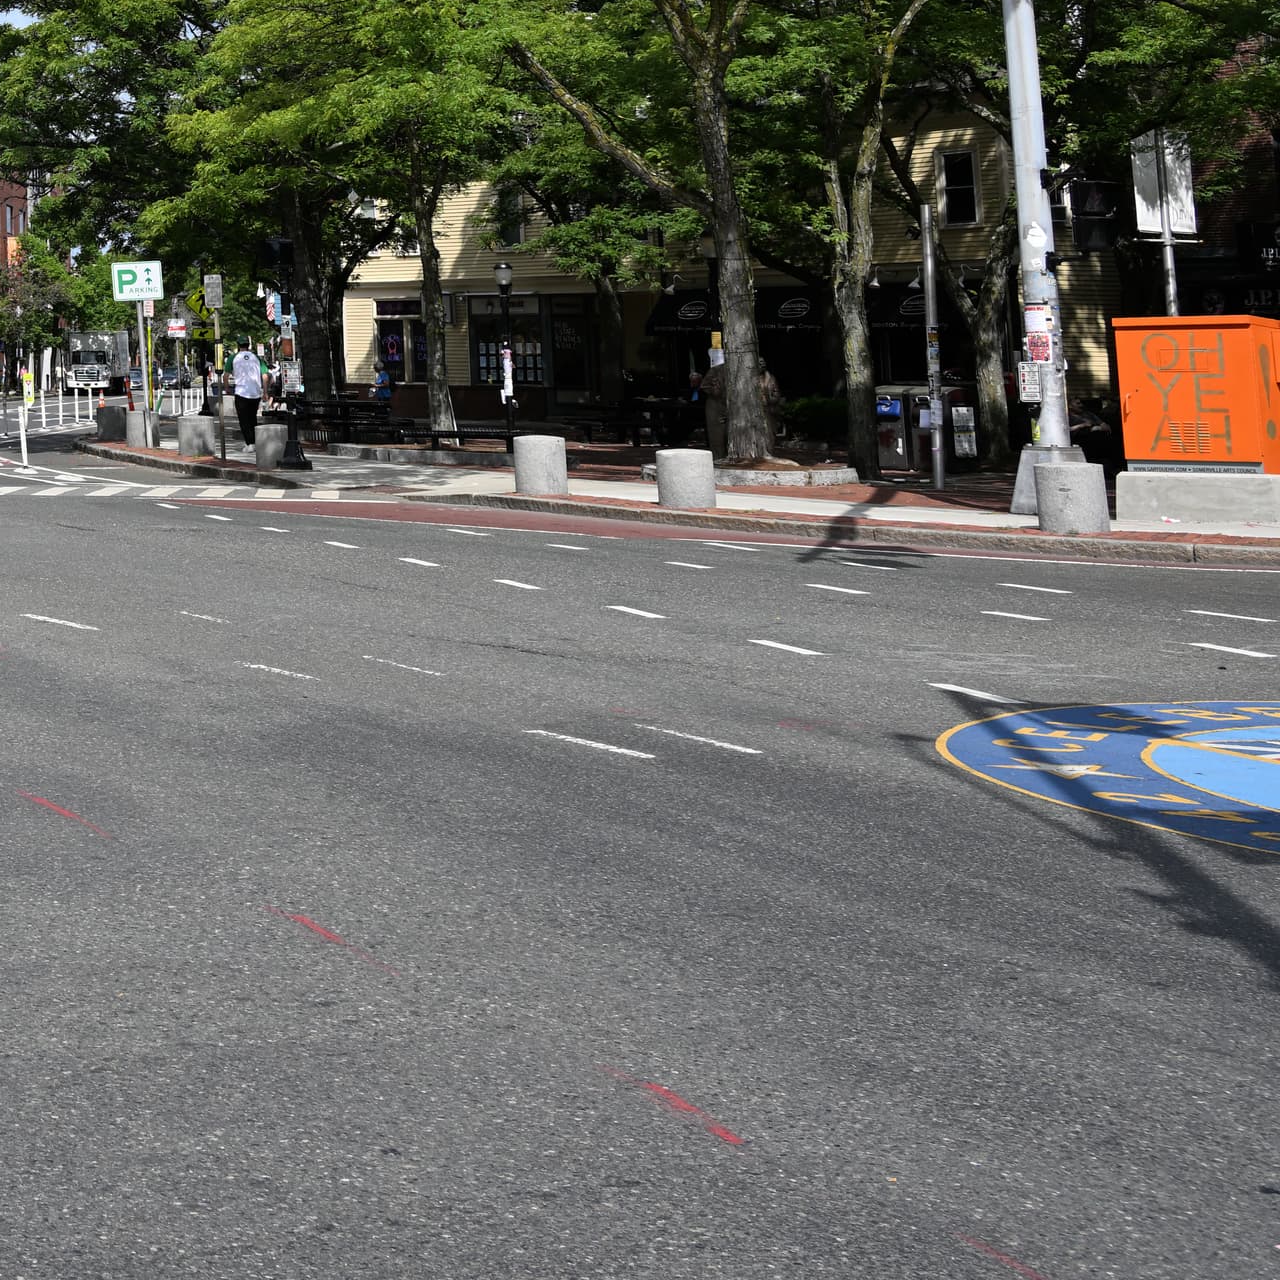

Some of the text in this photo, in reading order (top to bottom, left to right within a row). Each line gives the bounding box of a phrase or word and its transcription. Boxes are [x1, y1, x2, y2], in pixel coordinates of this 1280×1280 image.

[1141, 332, 1225, 372] OH
[1146, 373, 1230, 413] YE
[1150, 414, 1233, 456] AH
[1192, 466, 1222, 474] SOMERVILLE
